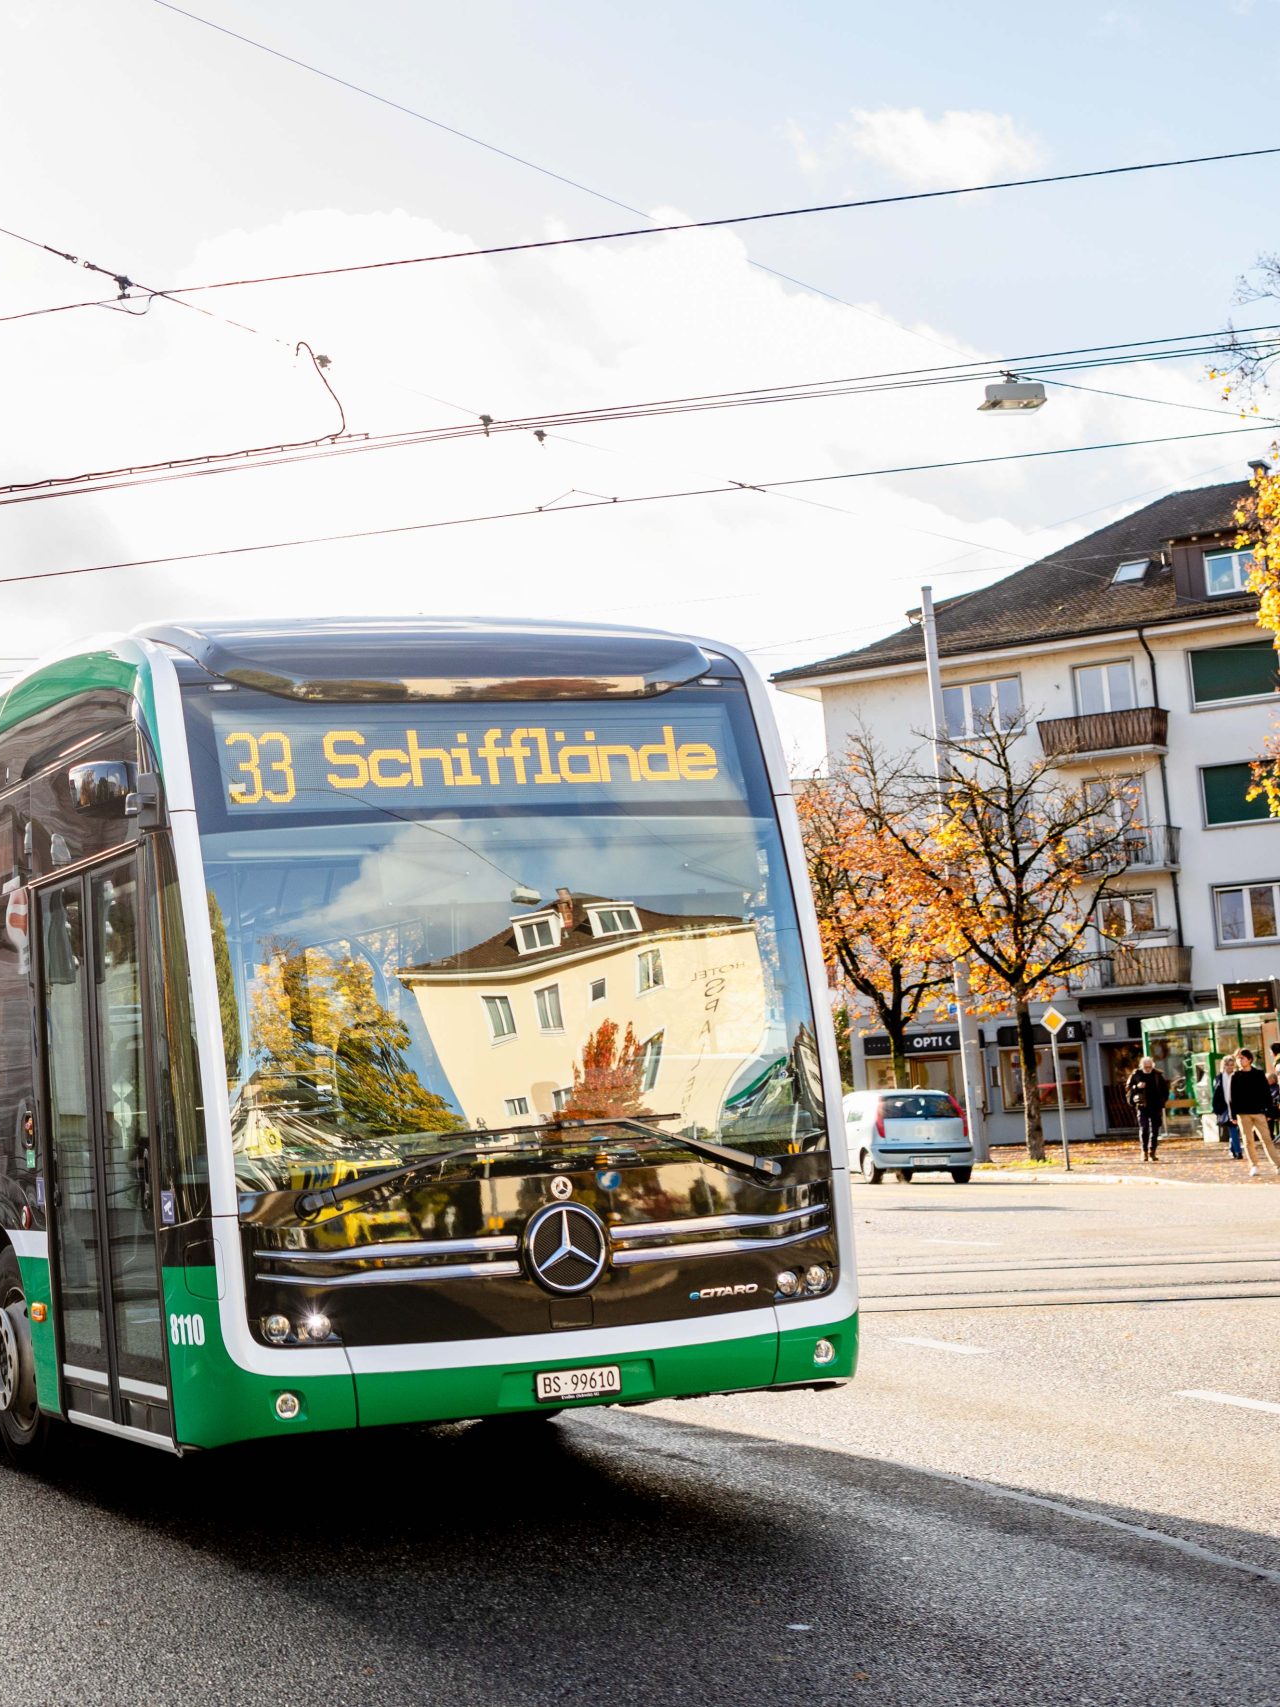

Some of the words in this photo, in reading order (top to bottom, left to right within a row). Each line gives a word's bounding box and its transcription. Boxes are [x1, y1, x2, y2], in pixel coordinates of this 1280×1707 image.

[225, 731, 296, 803] 33
[322, 726, 719, 789] Schifflände
[689, 1283, 759, 1301] eCITARO
[169, 1313, 206, 1346] 8110
